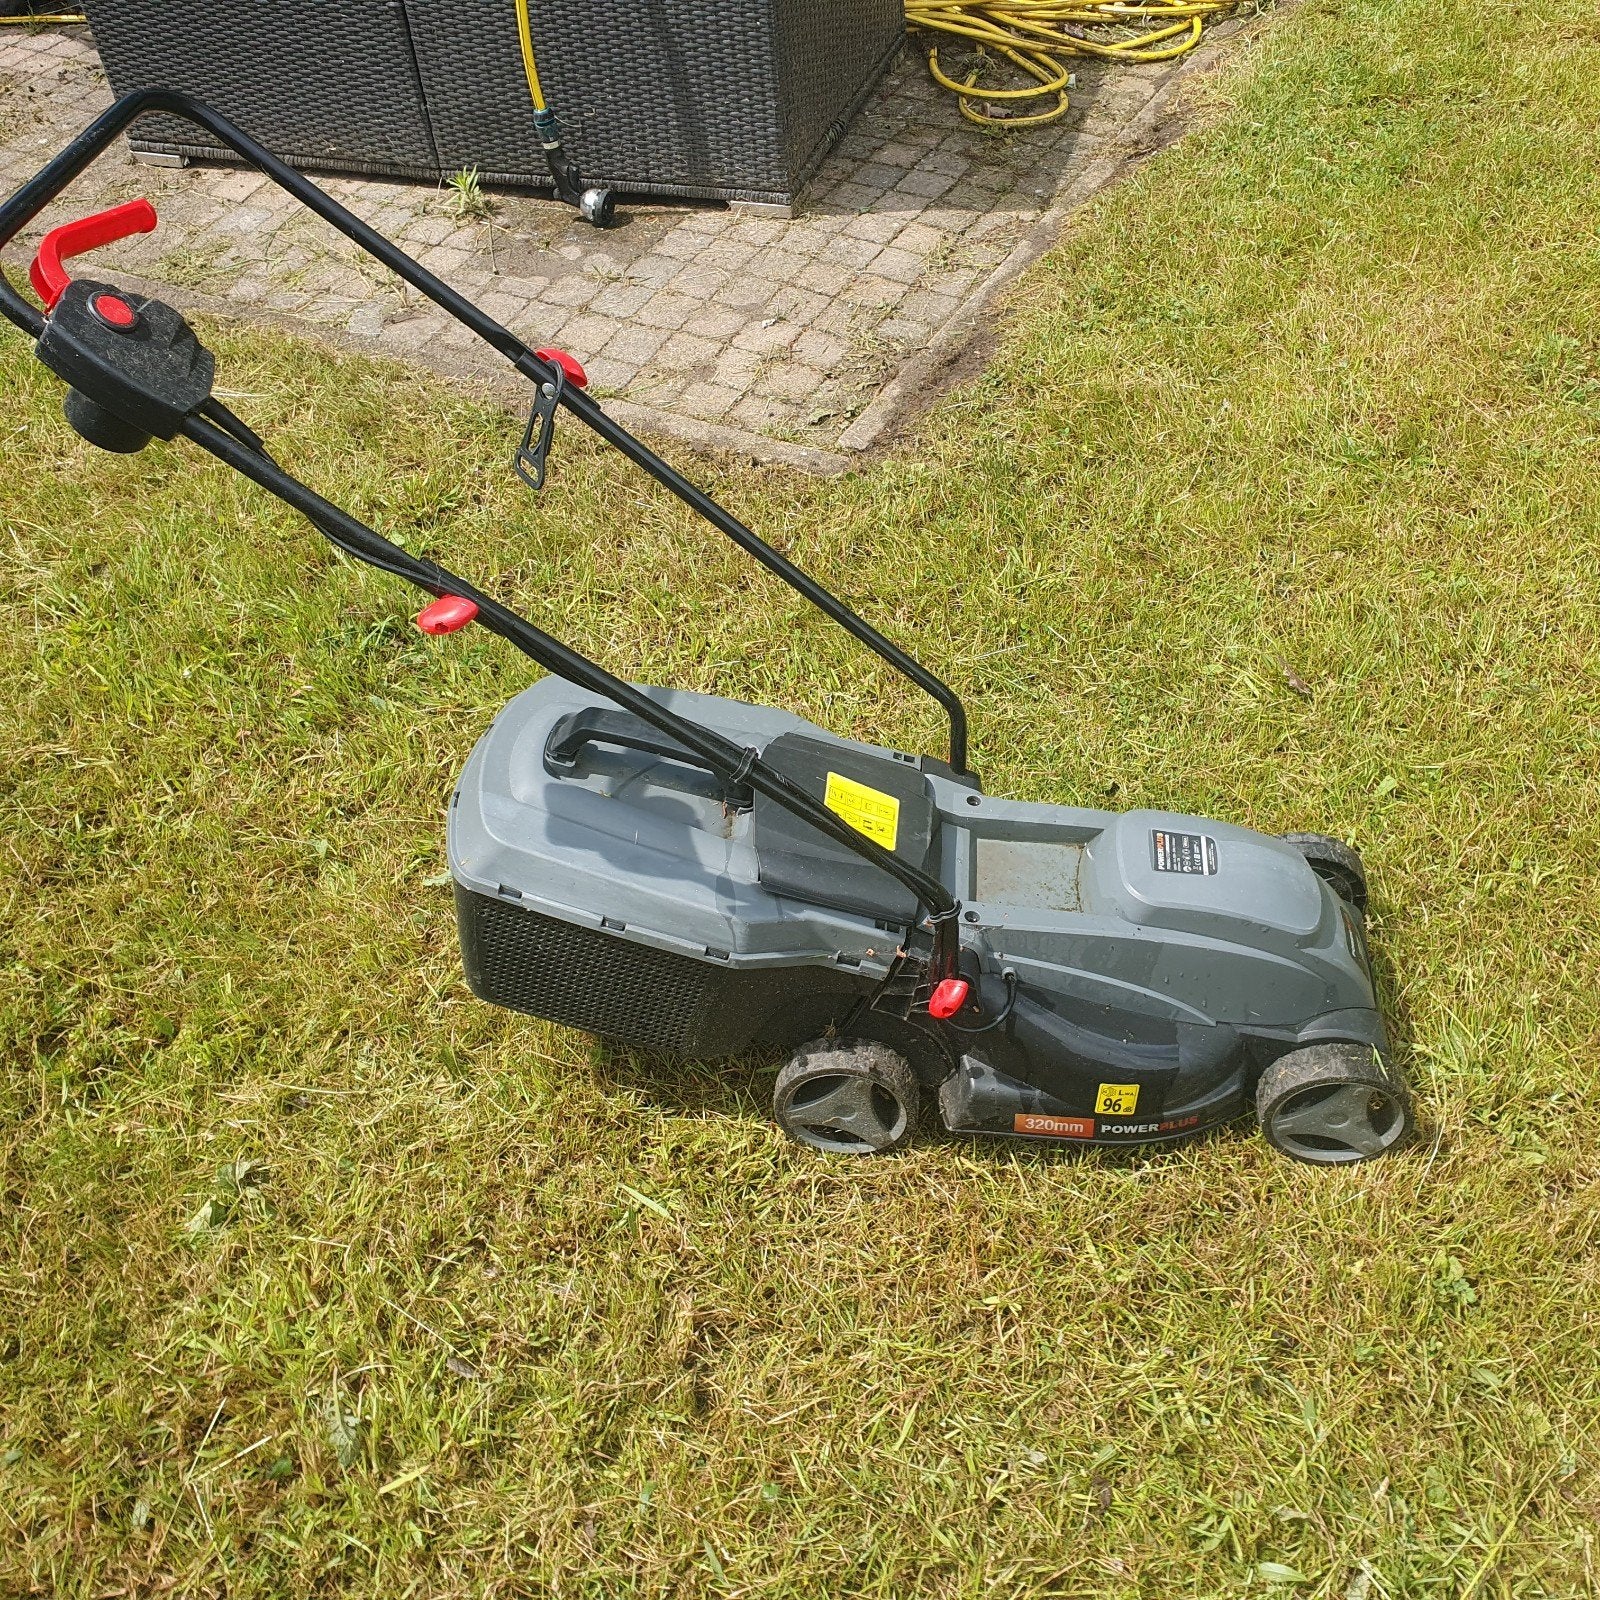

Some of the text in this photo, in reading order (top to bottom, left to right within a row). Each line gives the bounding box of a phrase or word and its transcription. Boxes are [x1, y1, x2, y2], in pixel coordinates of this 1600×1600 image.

[1103, 1097, 1122, 1112] 96
[1025, 1118, 1084, 1133] 320mm
[1101, 1116, 1198, 1134] POWERPLUS
